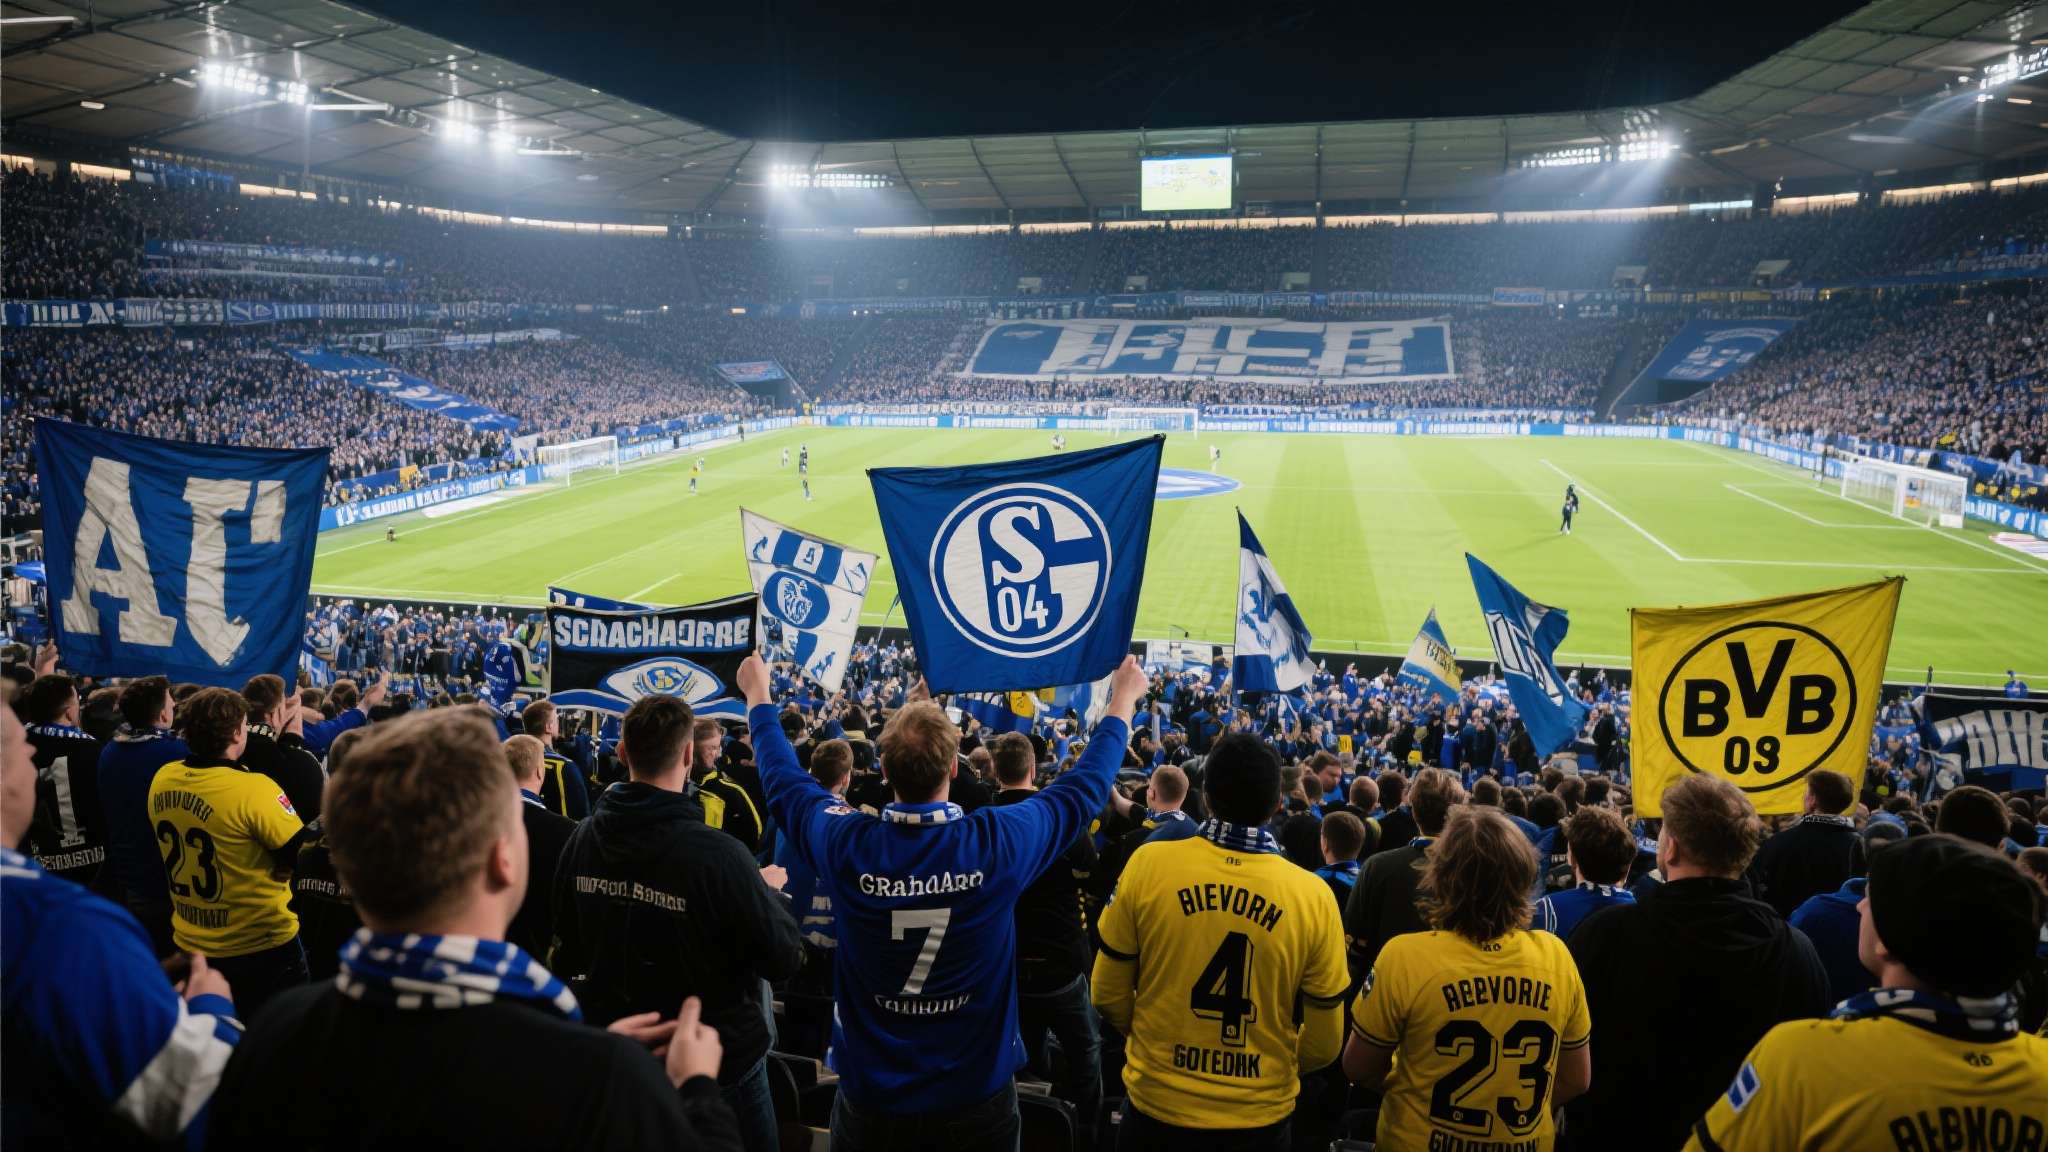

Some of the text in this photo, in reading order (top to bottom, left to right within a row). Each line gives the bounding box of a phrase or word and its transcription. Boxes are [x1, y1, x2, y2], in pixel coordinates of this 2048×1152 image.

[996, 583, 1049, 632] 04
[1682, 638, 1837, 738] BVB
[39, 755, 86, 848] 1
[156, 819, 224, 904] 23
[891, 907, 952, 995] 7
[1190, 931, 1258, 1048] 4
[1429, 1019, 1560, 1137] 23
